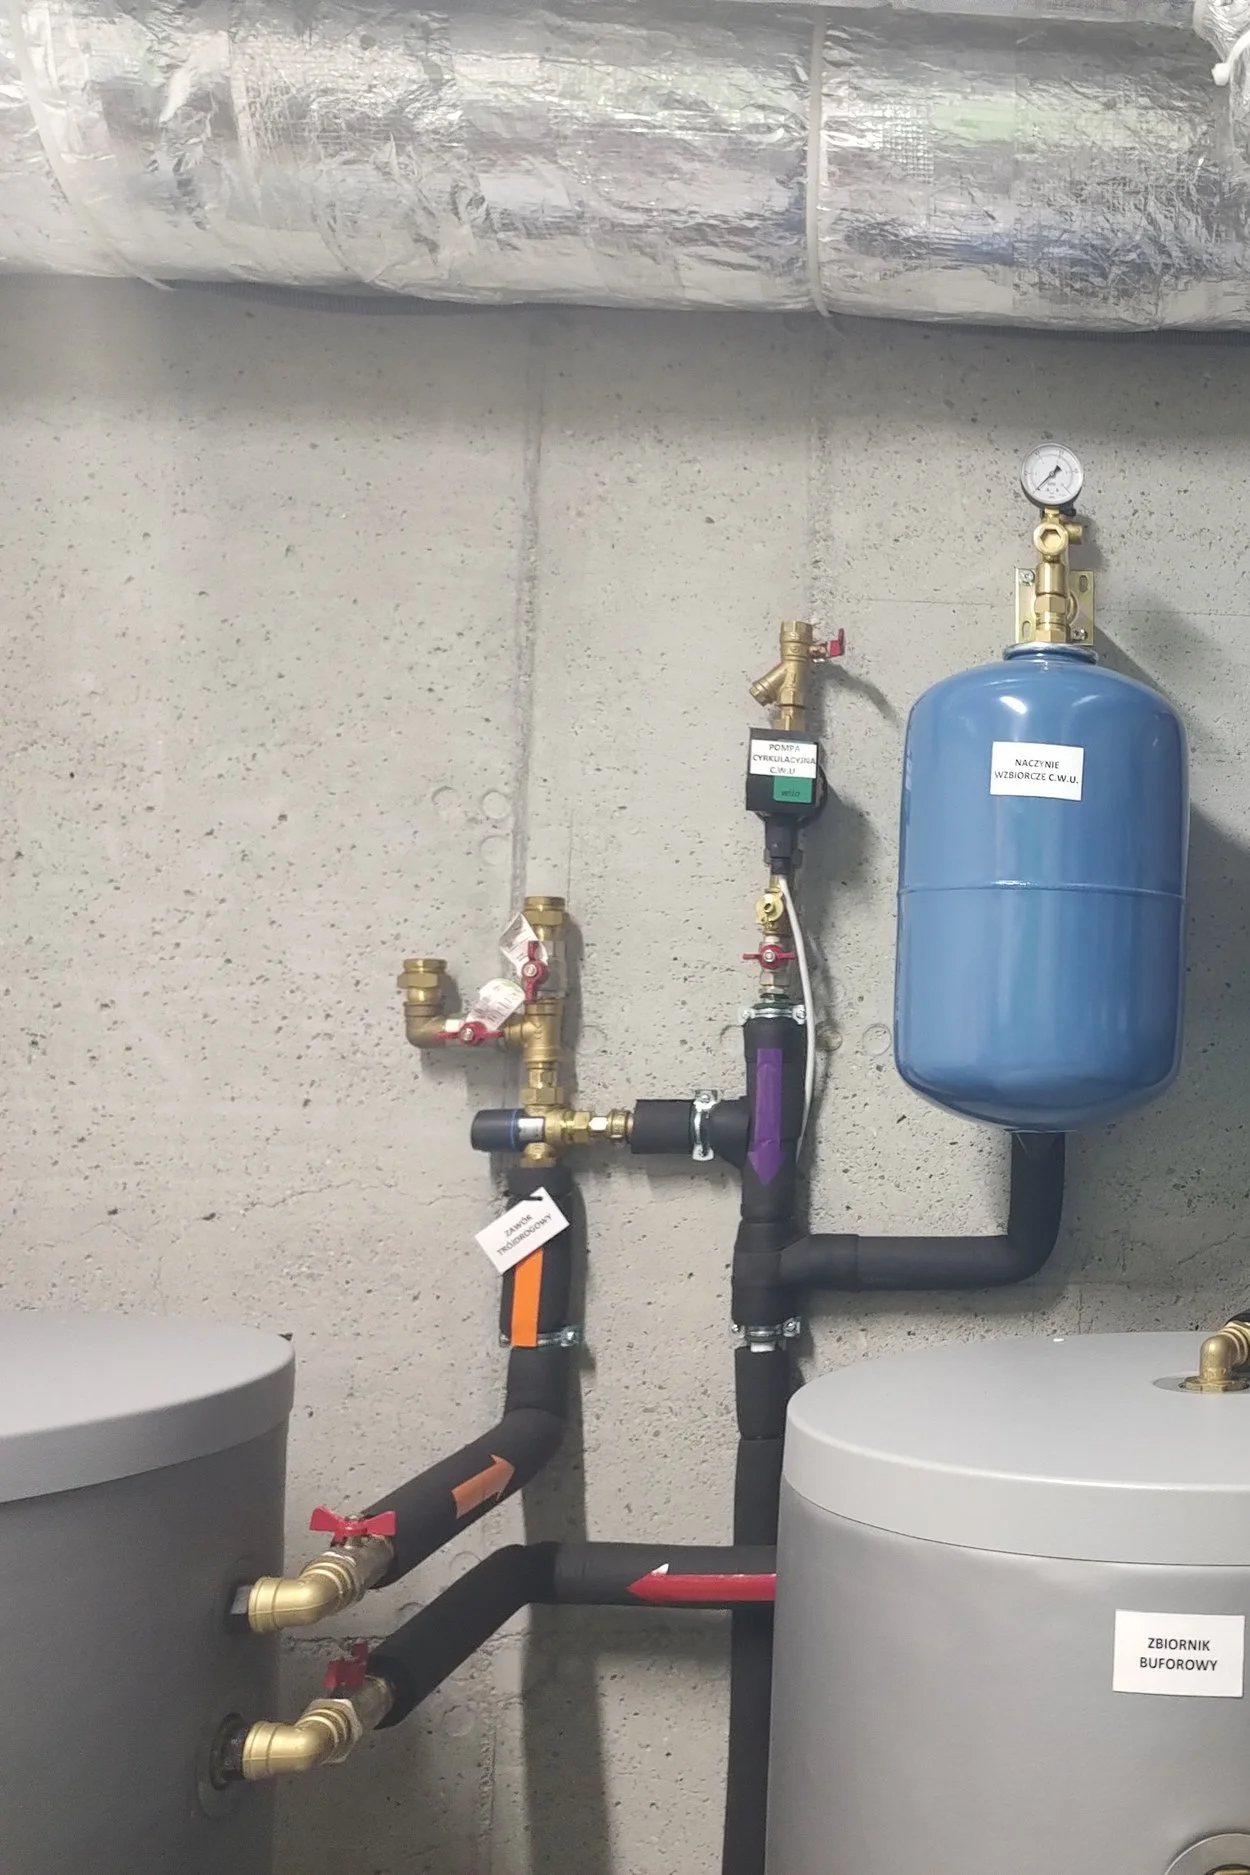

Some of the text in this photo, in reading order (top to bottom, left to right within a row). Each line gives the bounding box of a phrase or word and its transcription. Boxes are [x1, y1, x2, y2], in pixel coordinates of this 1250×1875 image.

[769, 744, 801, 752] POMPA
[752, 754, 816, 765] CYRKULACYJNA
[1014, 759, 1060, 769] NACZYNIE
[994, 771, 1079, 784] WZBIORCZE C.W.U.
[1147, 1637, 1210, 1651] ZBIORNIK
[1139, 1656, 1218, 1671] BUFOROWY
